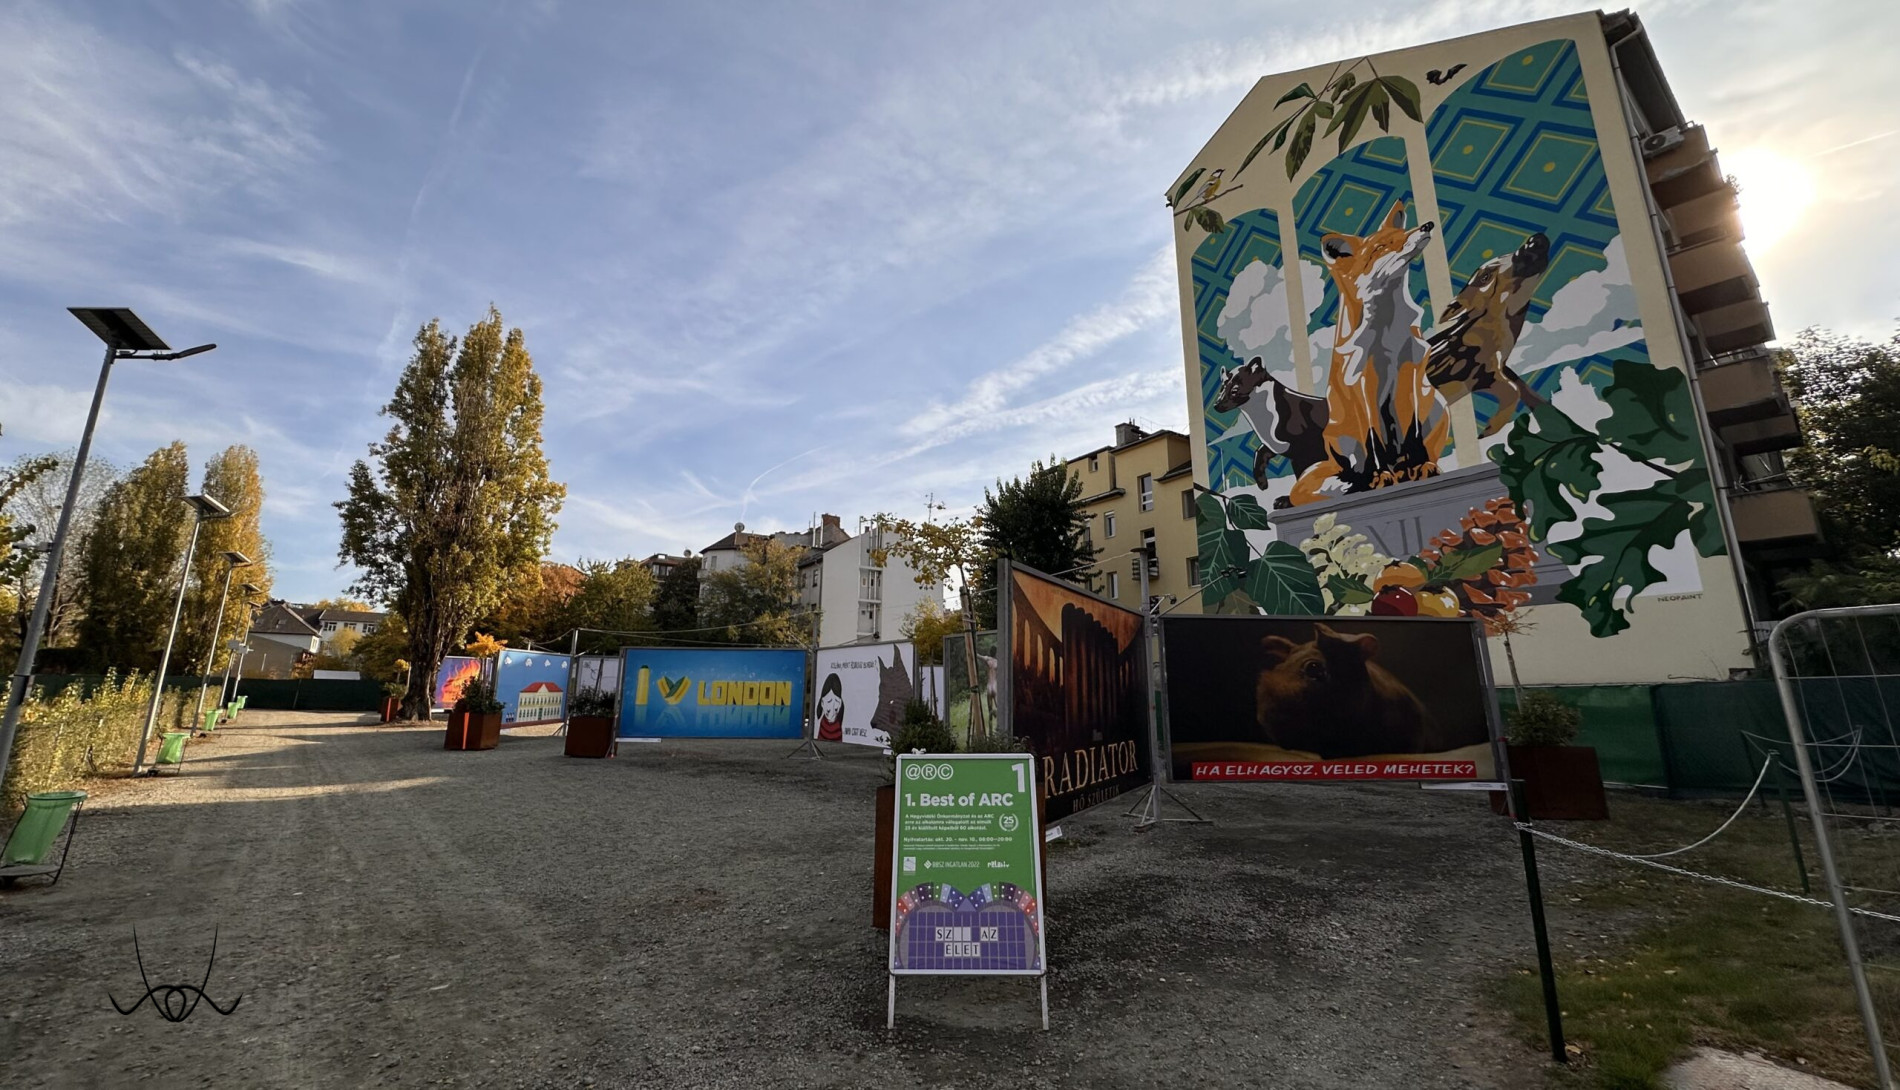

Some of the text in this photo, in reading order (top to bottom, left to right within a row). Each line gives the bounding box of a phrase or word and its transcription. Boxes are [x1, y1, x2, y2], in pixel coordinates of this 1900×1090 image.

[1657, 593, 1703, 602] NEOPAINT
[697, 680, 792, 706] LONDON
[1042, 740, 1138, 799] RADIATOR
[1196, 765, 1220, 776] HA
[1322, 764, 1378, 775] VELED
[1383, 764, 1475, 776] MEHETEK?
[1011, 763, 1025, 793] 1
[905, 792, 1014, 807] 1. Best of ARC
[1003, 816, 1014, 824] 25
[981, 928, 997, 939] AZ
